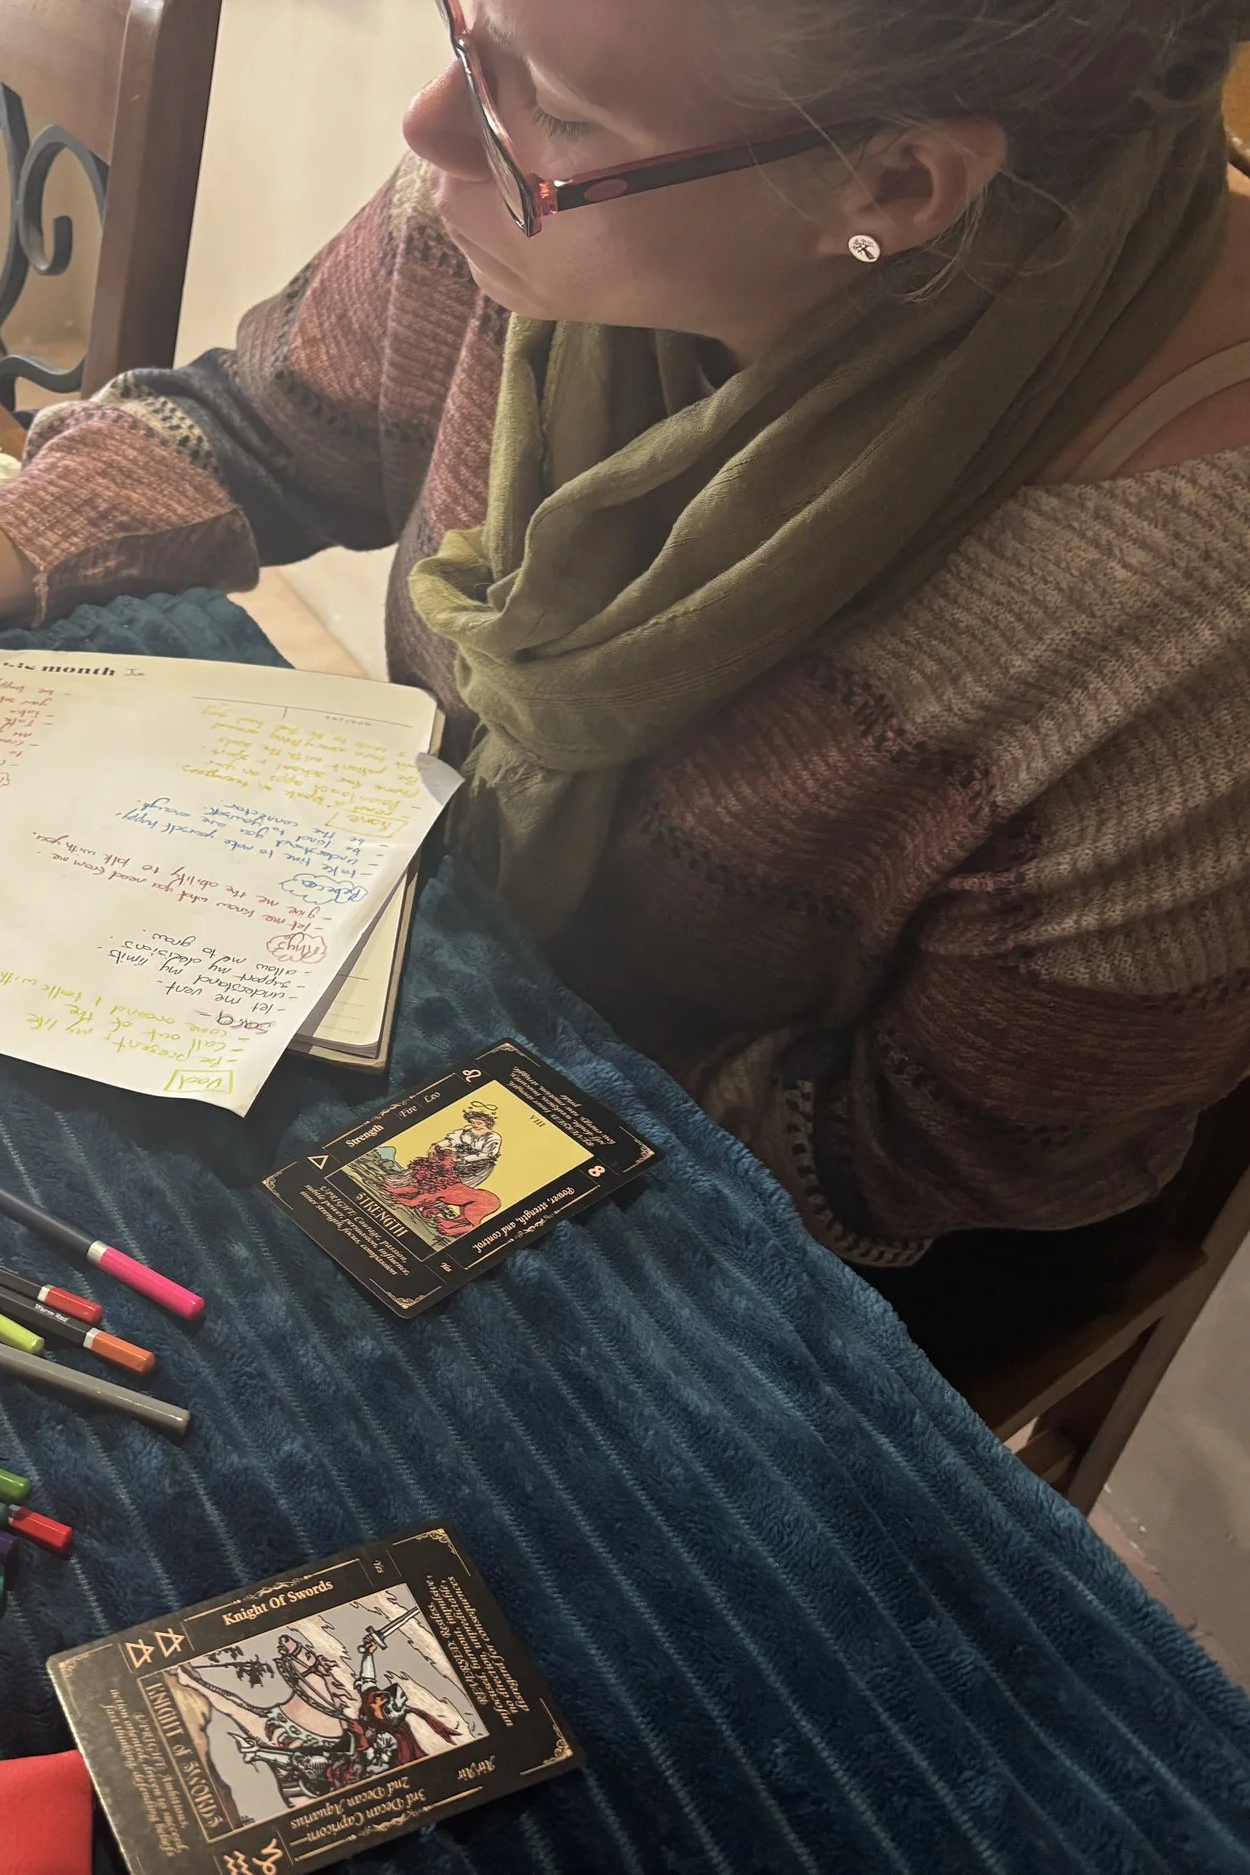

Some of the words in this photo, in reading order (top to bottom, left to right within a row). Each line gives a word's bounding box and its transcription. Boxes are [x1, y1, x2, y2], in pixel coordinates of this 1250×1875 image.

[42, 666, 116, 676] month
[65, 841, 96, 856] with
[259, 849, 274, 859] to
[107, 870, 147, 883] need
[141, 864, 160, 875] to
[168, 866, 219, 891] ability
[177, 890, 209, 904] what
[225, 885, 247, 899] the
[256, 895, 277, 907] me
[262, 914, 286, 925] me
[202, 947, 216, 959] to
[207, 954, 232, 974] my
[219, 955, 247, 964] me
[159, 956, 184, 975] my
[255, 963, 298, 977] allow
[192, 974, 286, 999] understand
[214, 993, 242, 1005] me
[345, 1124, 385, 1148] Strength
[423, 1091, 441, 1103] Leo
[546, 1186, 575, 1204] Power,
[355, 1192, 409, 1237] STRENGTH
[514, 1201, 549, 1226] strength,
[299, 1191, 319, 1205] inner
[315, 1204, 345, 1231] strength,
[337, 1227, 361, 1245] focus,
[359, 1244, 398, 1276] compassion
[304, 1184, 325, 1200] subtle
[320, 1200, 345, 1221] power,
[341, 1218, 379, 1249] persuasion,
[377, 1248, 410, 1276] influence,
[500, 1221, 516, 1237] and
[379, 1240, 408, 1264] passion,
[472, 1230, 502, 1254] control.
[221, 1603, 269, 1626] Knight
[269, 1594, 287, 1609] Of
[286, 1580, 334, 1603] Swords
[425, 1575, 459, 1625] impulsive,
[447, 1576, 490, 1642] consequences
[427, 1601, 452, 1639] Restless,
[440, 1579, 482, 1649] unpredictable,
[453, 1626, 481, 1670] burnout,
[485, 1643, 505, 1666] for
[447, 1641, 489, 1705] REVERSED:
[479, 1651, 510, 1698] direction,
[494, 1662, 530, 1712] disregard
[475, 1671, 514, 1727] unfocused,
[505, 1699, 519, 1714] no
[145, 1682, 184, 1737] KNIGHT
[183, 1762, 224, 1828] SWORDS
[346, 1786, 385, 1807] Decan
[386, 1776, 410, 1797] 2nd
[365, 1797, 404, 1819] Decan
[405, 1788, 426, 1809] 3rd
[290, 1798, 345, 1830] Aquarius
[306, 1811, 365, 1842] Capricorn
